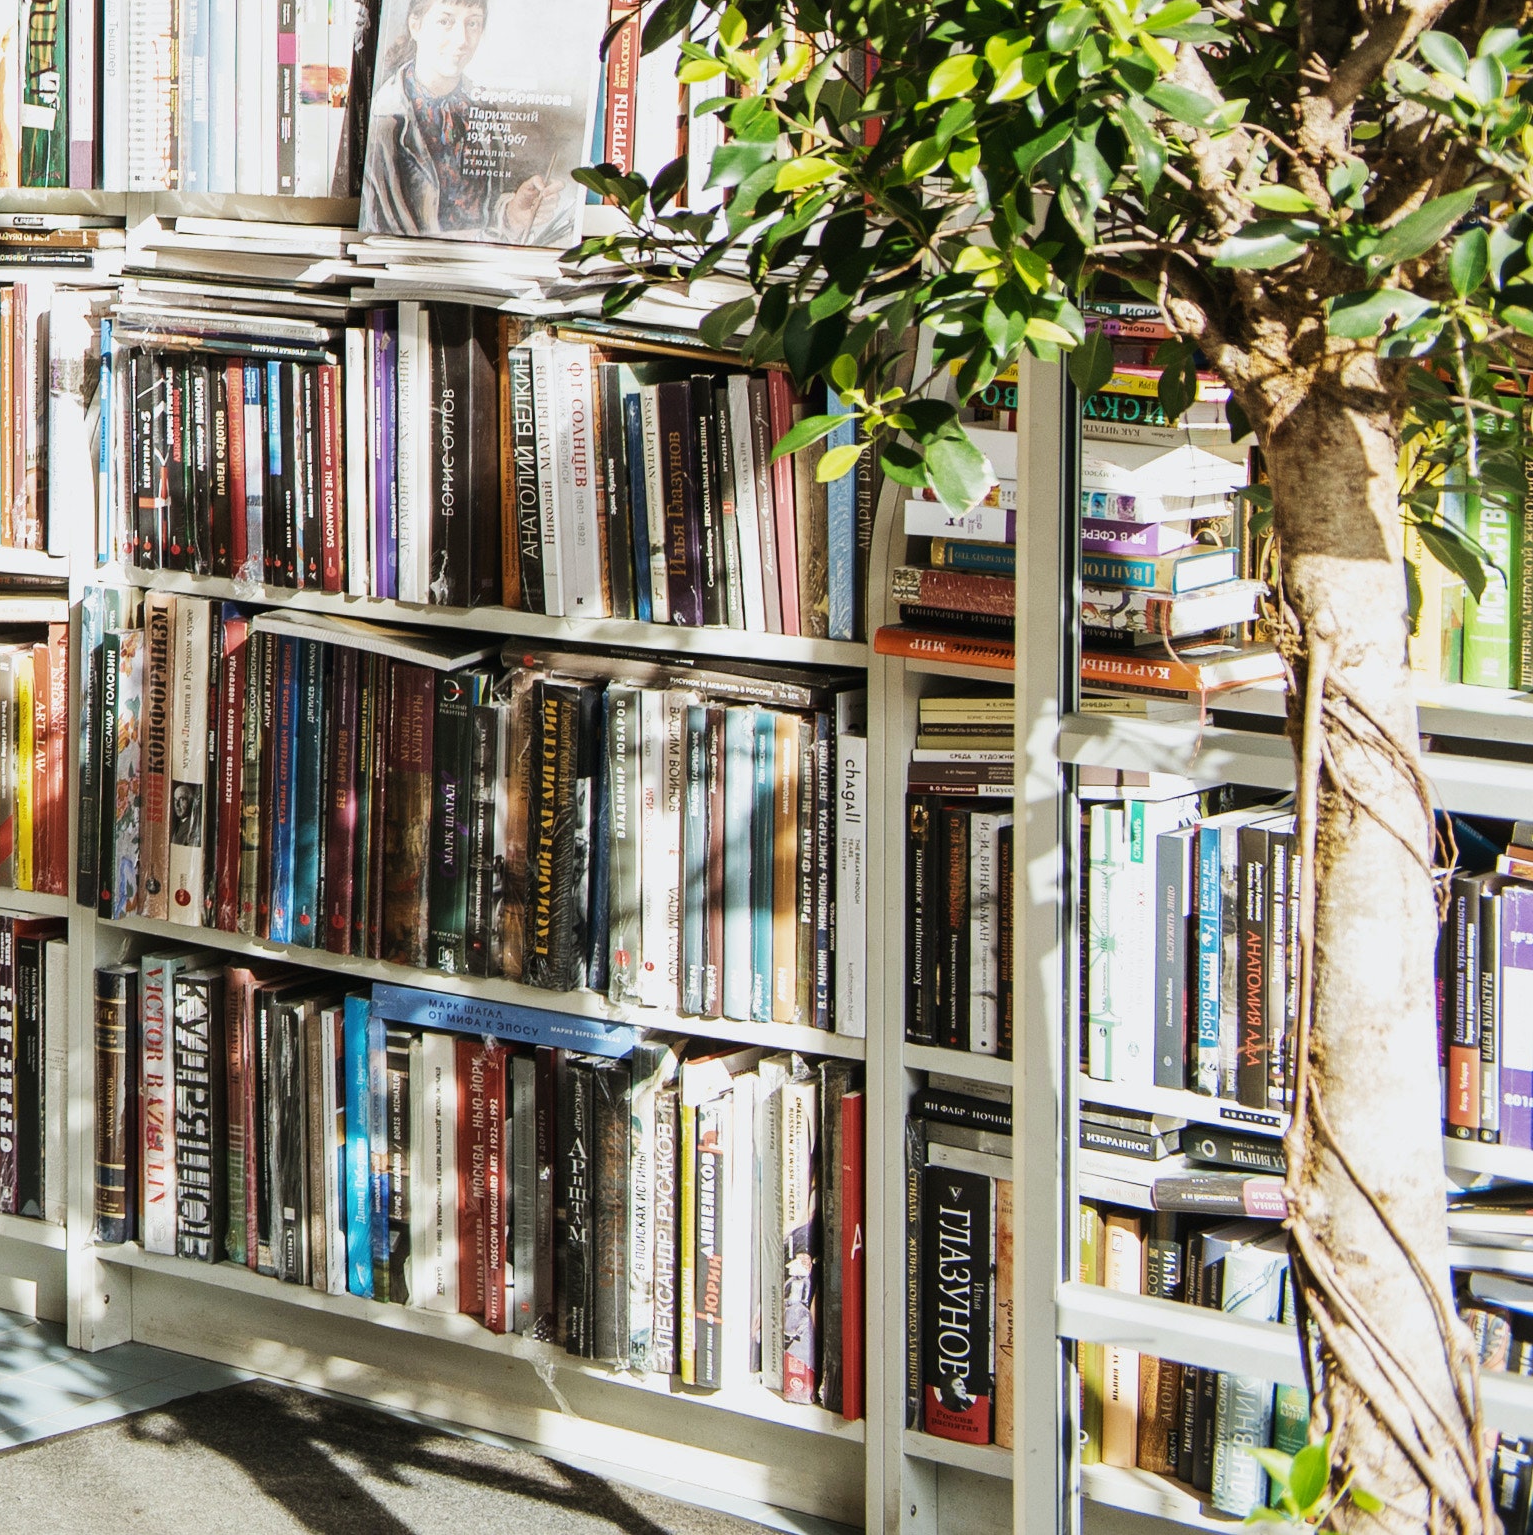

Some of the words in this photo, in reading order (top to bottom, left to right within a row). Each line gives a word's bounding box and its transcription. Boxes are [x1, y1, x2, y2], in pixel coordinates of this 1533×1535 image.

[470, 88, 572, 108] Серебрякова
[469, 106, 539, 123] Парижский
[468, 120, 511, 133] период
[142, 966, 165, 1054] VICTOR
[428, 999, 461, 1013] МАРК
[464, 1006, 503, 1020] ШАГАЛ
[428, 1011, 444, 1022] ОТ
[446, 1014, 482, 1028] МИФА
[485, 1020, 493, 1030] К
[496, 1022, 540, 1037] ЭПОСУ
[147, 1060, 166, 1208] RAZGULIN
